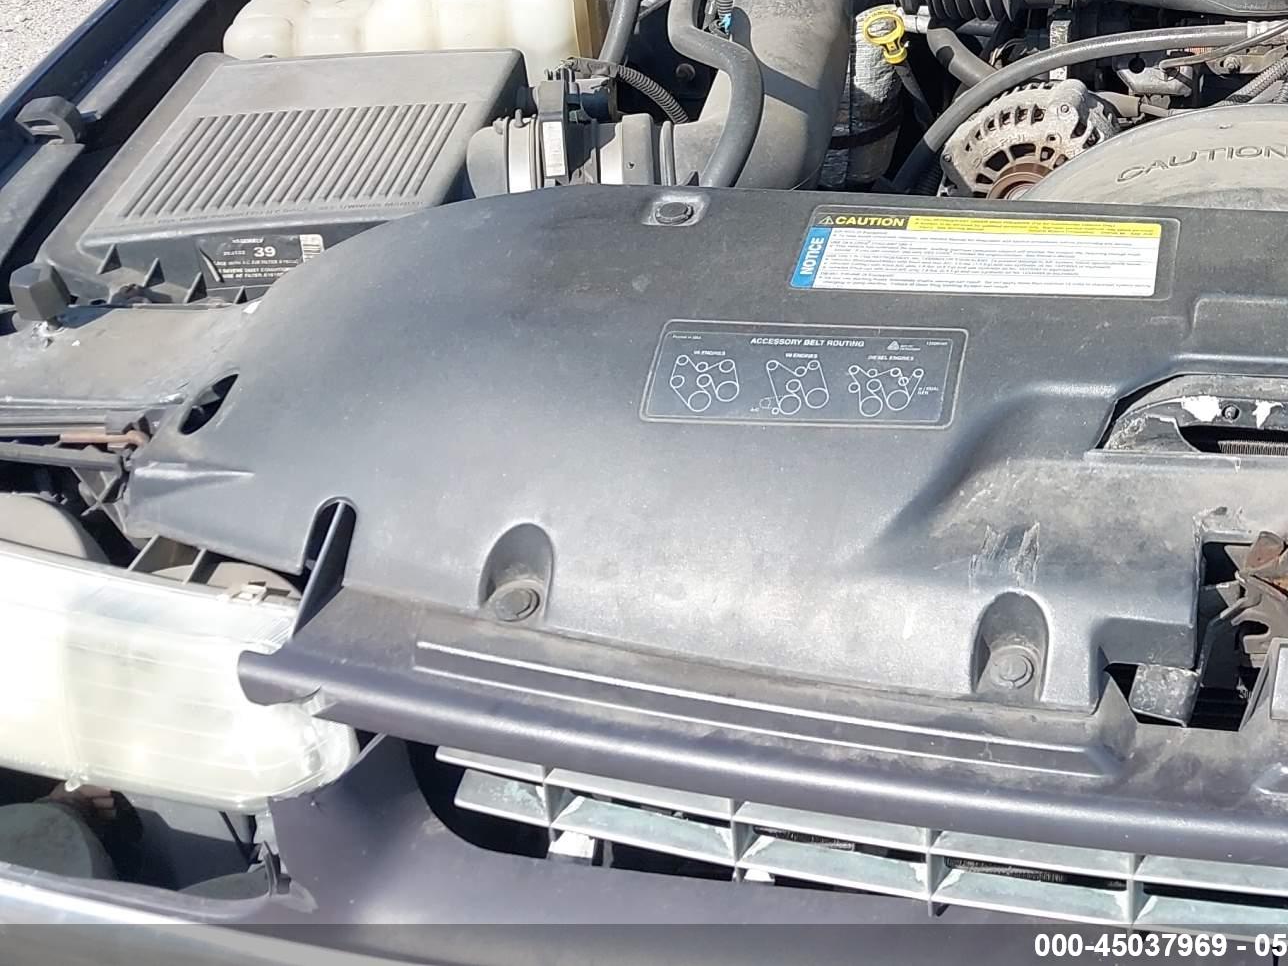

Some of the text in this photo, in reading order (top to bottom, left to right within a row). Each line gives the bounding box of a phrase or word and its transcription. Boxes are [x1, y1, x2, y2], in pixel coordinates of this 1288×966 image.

[835, 215, 905, 227] CAUTION
[252, 245, 276, 258] 39
[799, 236, 825, 275] NOTICE
[750, 337, 865, 348] ACCESSORY BELT ROUTING
